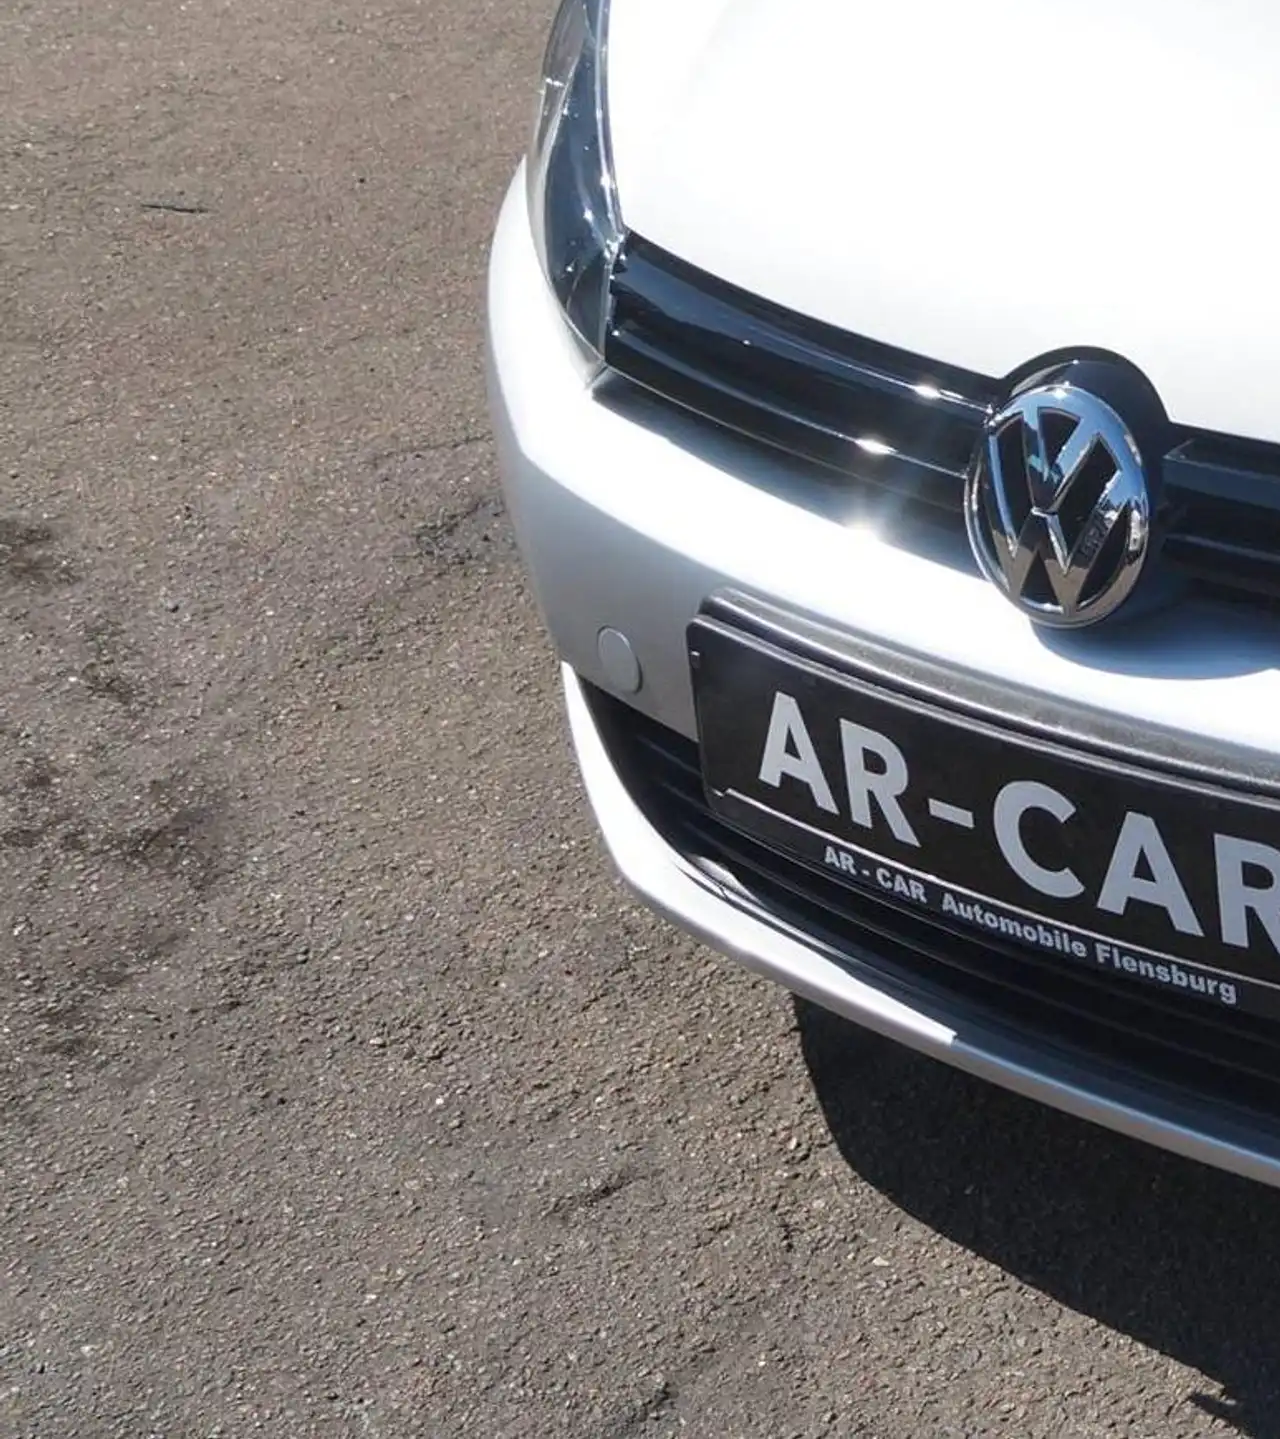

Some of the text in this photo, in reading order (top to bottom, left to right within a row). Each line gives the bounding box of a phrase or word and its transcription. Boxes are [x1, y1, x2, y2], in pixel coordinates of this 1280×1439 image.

[823, 845, 859, 875] AR
[875, 867, 928, 903] CAR
[941, 892, 1088, 958] Automobile
[1095, 942, 1238, 1005] Flensburg
